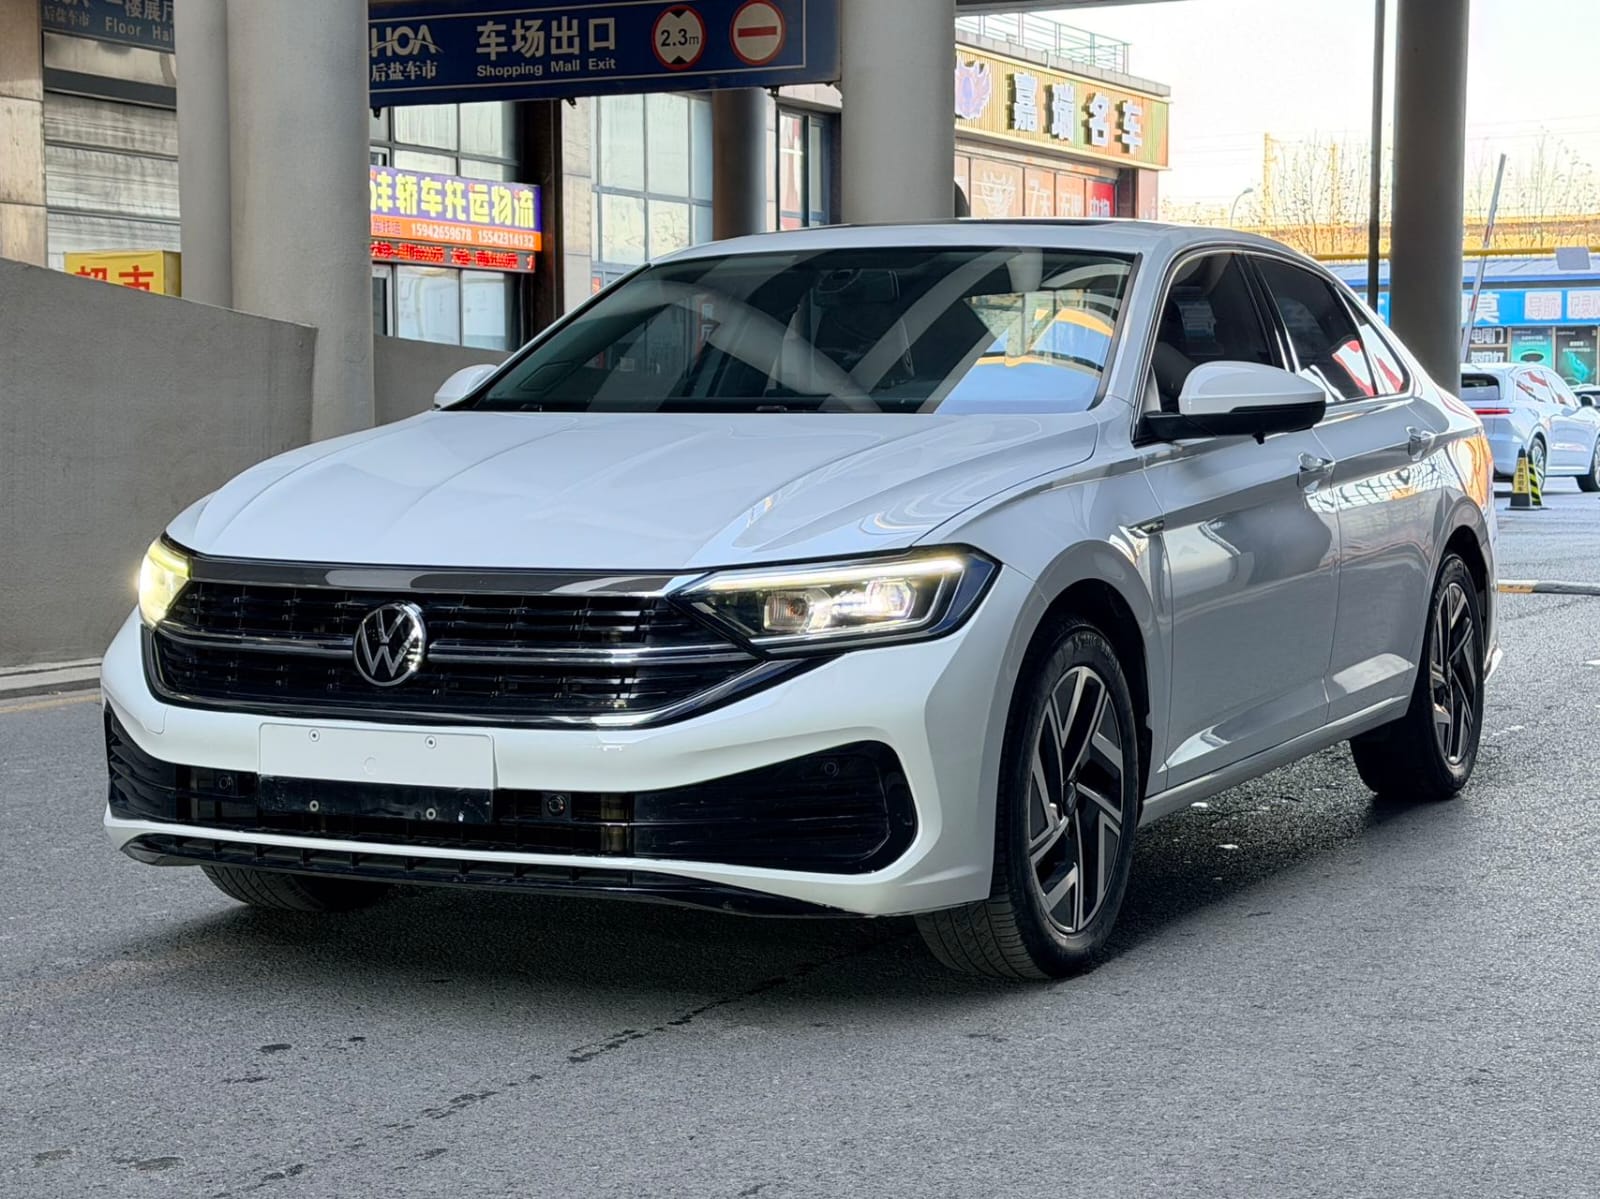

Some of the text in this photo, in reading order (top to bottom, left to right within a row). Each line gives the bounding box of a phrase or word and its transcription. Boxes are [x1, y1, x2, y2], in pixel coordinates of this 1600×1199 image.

[105, 16, 142, 36] Floor
[476, 16, 617, 61] 车场出口
[660, 28, 699, 47] 2.3m
[371, 60, 438, 82] 后盐车市
[476, 57, 617, 78] Shopping Mall Exit
